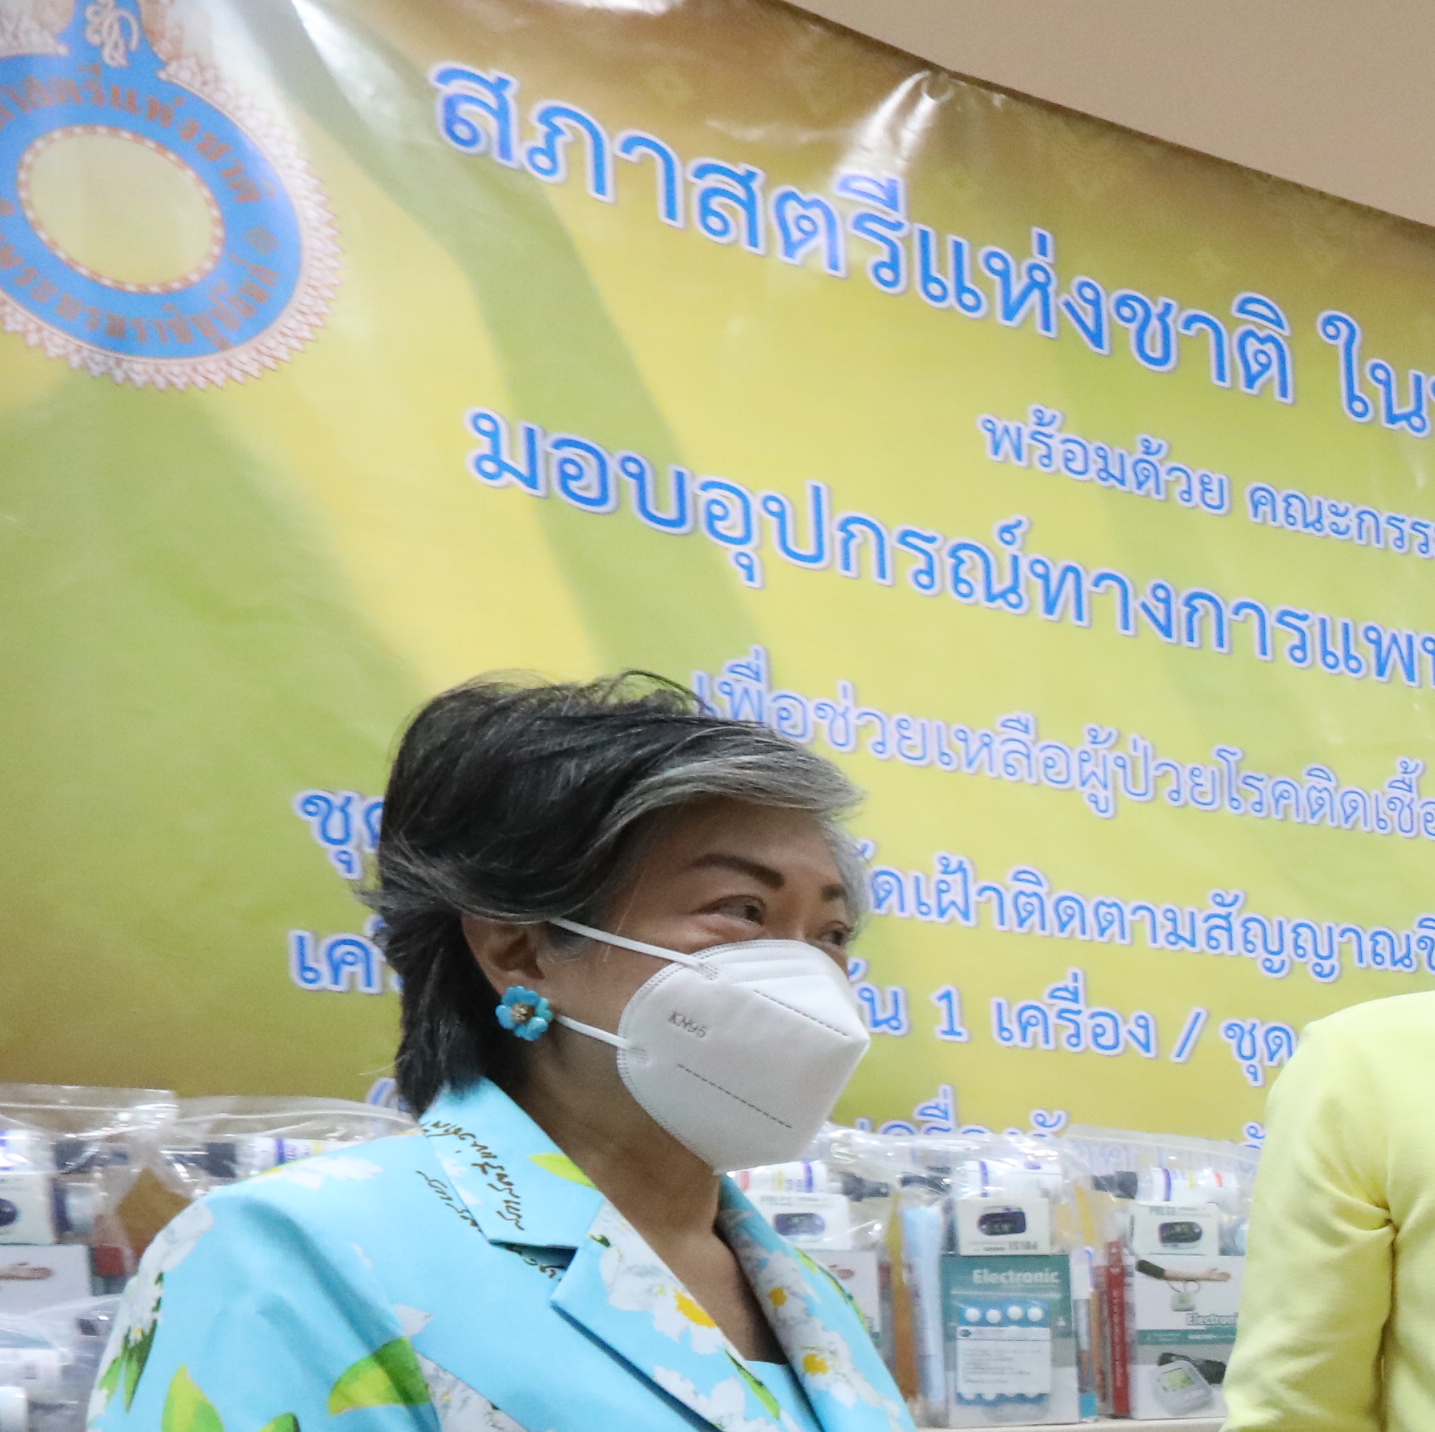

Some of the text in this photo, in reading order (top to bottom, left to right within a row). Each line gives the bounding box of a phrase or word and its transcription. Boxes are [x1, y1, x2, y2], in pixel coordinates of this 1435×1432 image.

[433, 65, 1292, 402] สภาสตรีแห่งชาติ
[979, 406, 1229, 514] พร้อมด้วย
[934, 987, 965, 1039] 1
[993, 969, 1156, 1056] เครื่อง
[972, 1268, 1060, 1285] Electronic
[1185, 1312, 1239, 1326] Electroni
